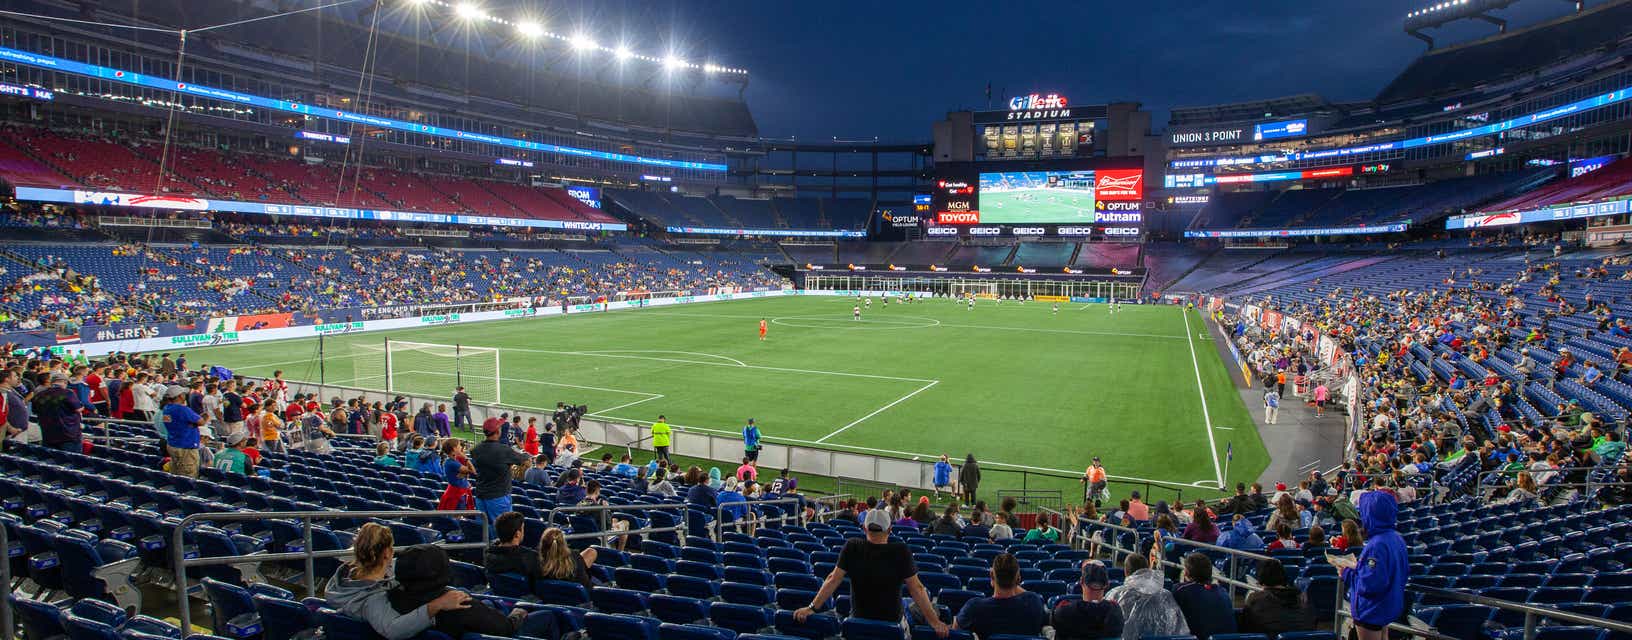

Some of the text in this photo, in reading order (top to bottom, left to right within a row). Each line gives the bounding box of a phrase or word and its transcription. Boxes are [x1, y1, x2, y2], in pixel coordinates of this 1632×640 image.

[1009, 93, 1068, 111] Gillette
[1007, 109, 1071, 120] STADIUM
[1172, 132, 1203, 144] UNION
[1212, 129, 1242, 141] POINT
[1361, 162, 1390, 174] Party City
[947, 201, 970, 209] MGM
[1107, 202, 1140, 211] OPTUM
[892, 215, 919, 223] OPTUM
[940, 213, 978, 222] TOYOTA
[1095, 212, 1141, 222] Putnam
[564, 221, 602, 230] WHITECAPS
[928, 227, 958, 235] GEICO
[969, 227, 1000, 235] GEICO
[1013, 227, 1045, 235] GEICO
[1058, 227, 1091, 235] GEICO
[1104, 227, 1139, 235] GEICO
[315, 323, 344, 332] SULLIVAN
[171, 331, 239, 345] SULLIVAN TIRE
[771, 481, 782, 494] 12
